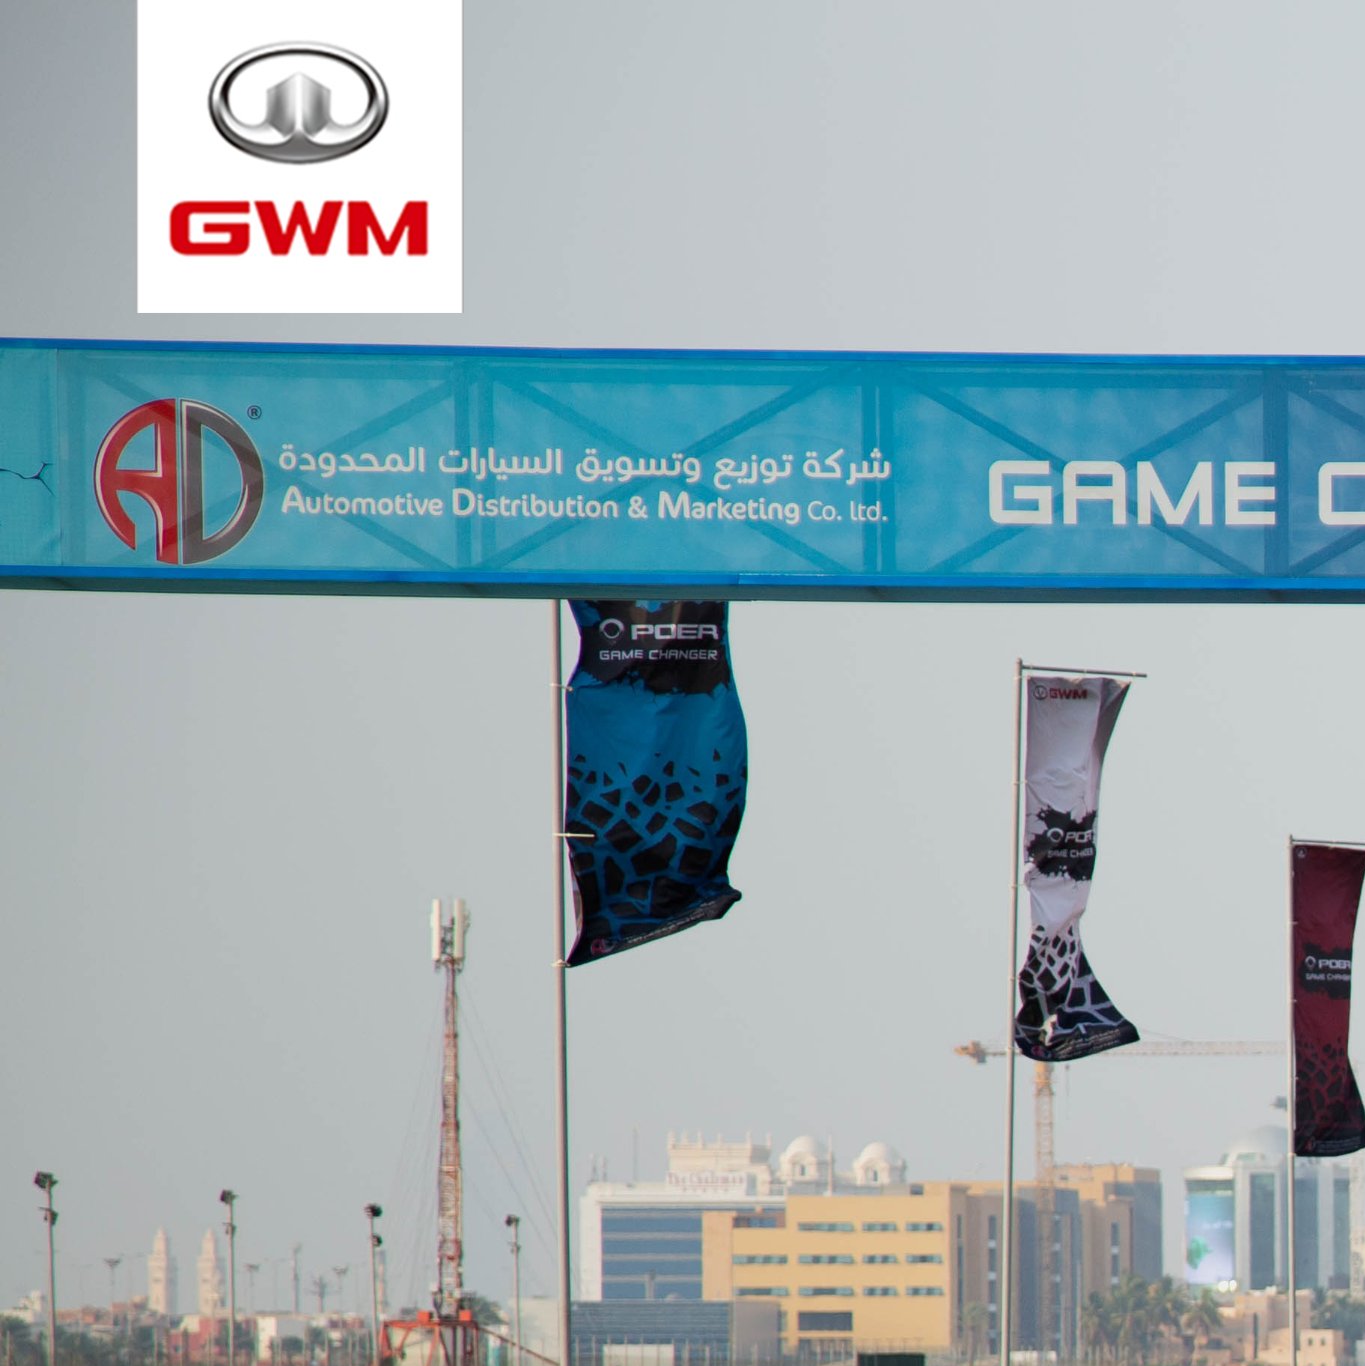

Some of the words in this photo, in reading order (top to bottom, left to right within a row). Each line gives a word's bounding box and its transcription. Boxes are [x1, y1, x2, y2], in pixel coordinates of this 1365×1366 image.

[278, 443, 425, 479] المحدودة
[437, 446, 563, 481] السيارات
[575, 447, 701, 483] وتسويق
[712, 452, 794, 490] توزيع
[803, 447, 891, 486] شركة
[281, 484, 443, 516] Automotive
[452, 487, 619, 519] Distribution
[626, 495, 649, 520] &
[657, 490, 799, 526] Marketing
[807, 500, 843, 521] Co.
[988, 459, 1276, 526] GAME
[631, 624, 719, 640] POER
[599, 649, 643, 661] GAME
[648, 649, 718, 660] CHANGER
[1049, 687, 1089, 699] GWM
